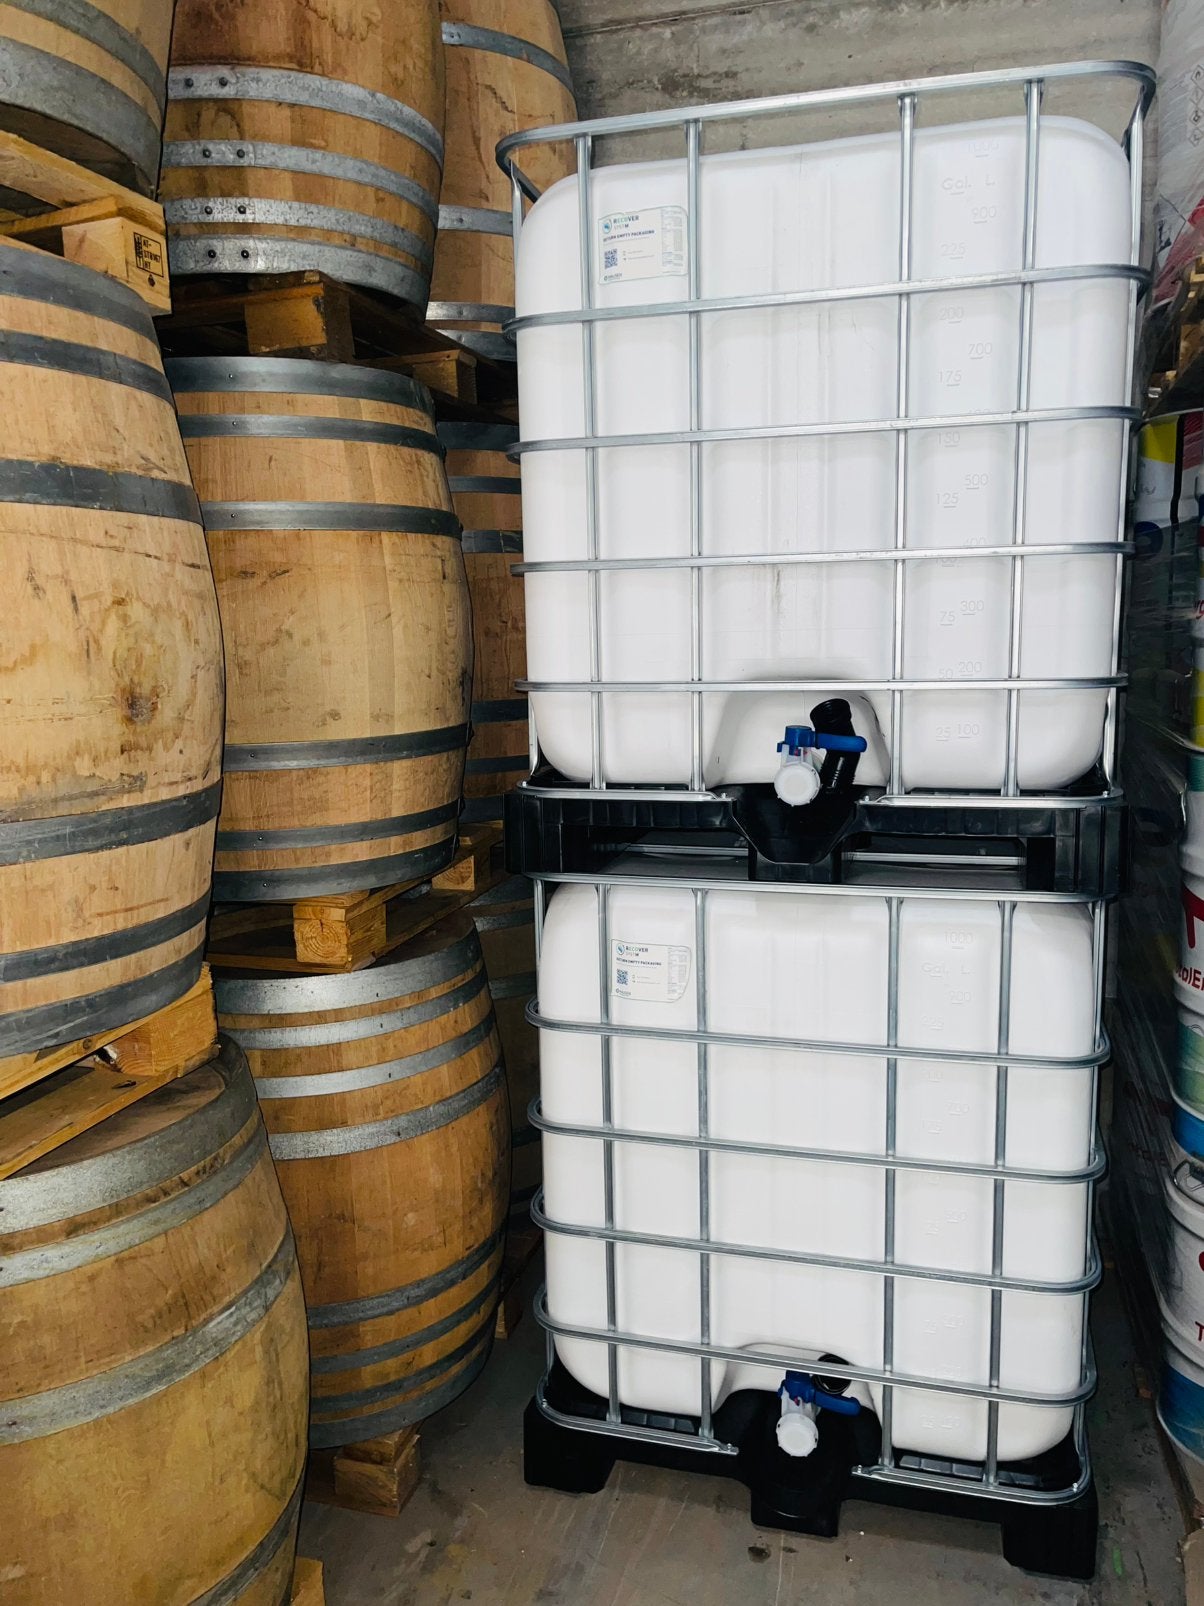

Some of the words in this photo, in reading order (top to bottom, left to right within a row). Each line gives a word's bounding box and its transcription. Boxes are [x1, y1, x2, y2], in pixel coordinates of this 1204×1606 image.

[941, 175, 972, 191] Gal.
[985, 174, 995, 186] L.
[971, 205, 997, 219] 900
[613, 215, 639, 224] RECOVER
[940, 243, 966, 257] 225
[939, 306, 965, 320] 200
[968, 342, 993, 356] 700
[938, 370, 963, 384] 175
[937, 431, 961, 445] 150
[964, 473, 989, 487] 500
[936, 493, 960, 506] 125
[960, 600, 985, 613] 300
[939, 611, 956, 624] 75
[958, 661, 983, 674] 200
[936, 727, 952, 740] 25
[956, 723, 980, 737] 100
[943, 931, 973, 944] 1000
[921, 962, 949, 976] Gal.
